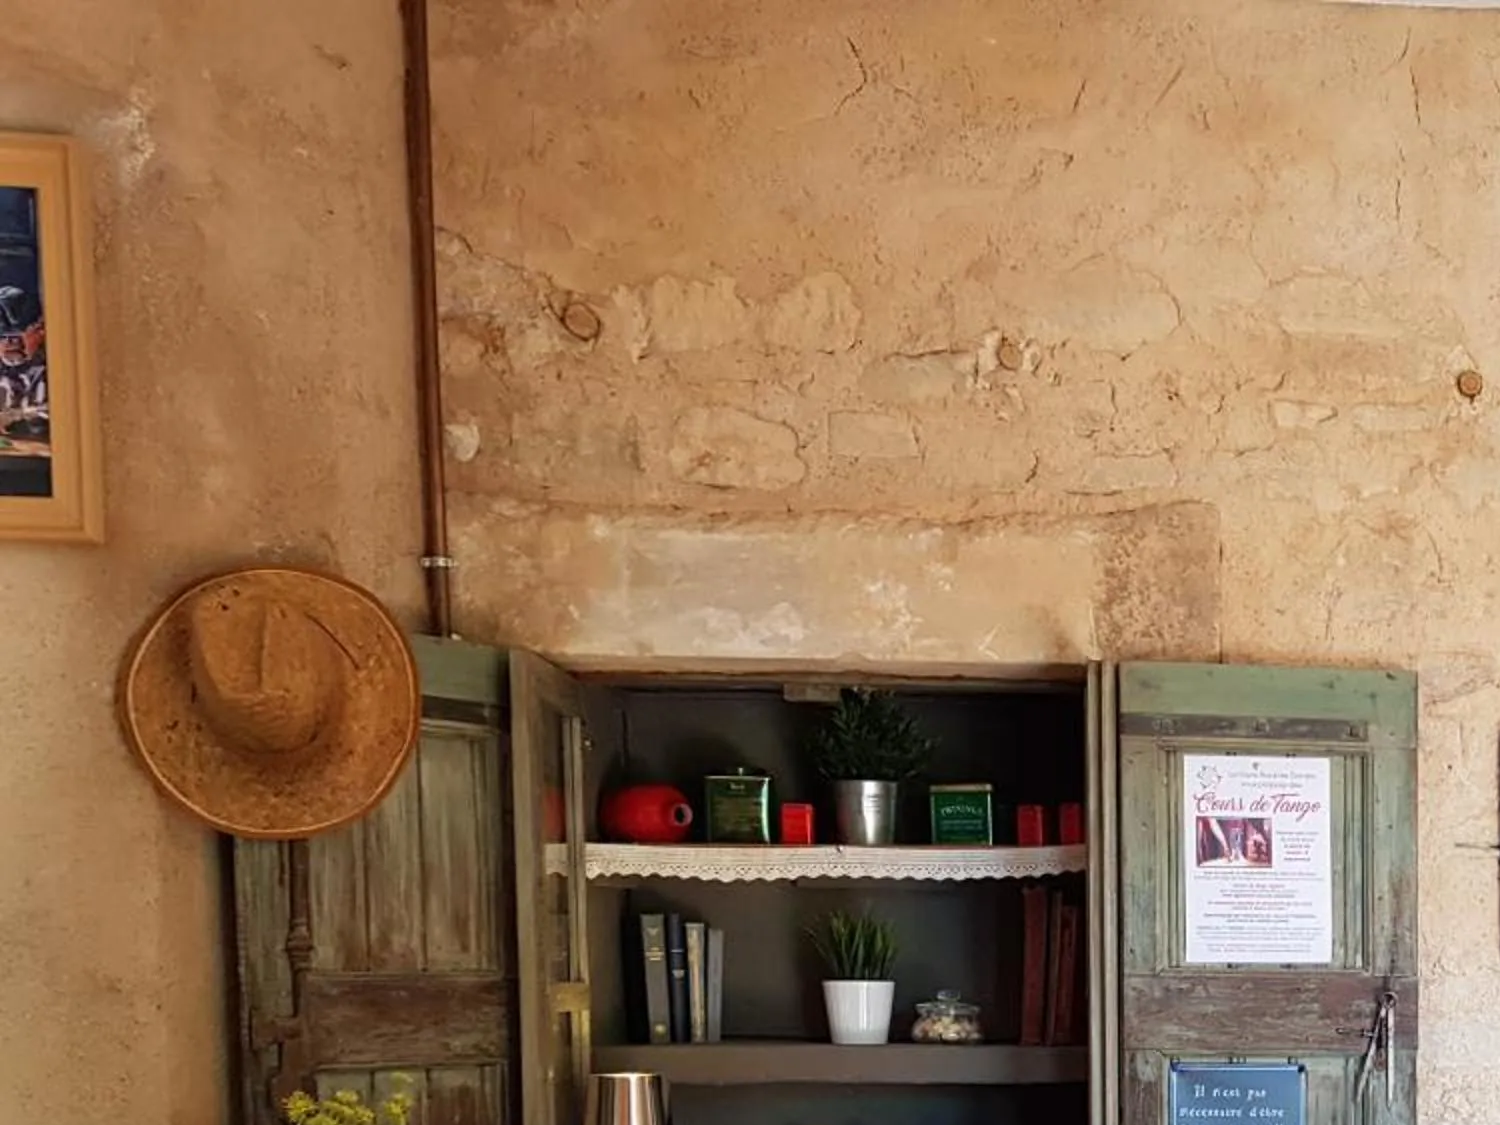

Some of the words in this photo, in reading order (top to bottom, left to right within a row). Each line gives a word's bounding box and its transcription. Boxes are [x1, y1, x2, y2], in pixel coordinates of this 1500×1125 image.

[1193, 791, 1245, 813] Cours
[1249, 794, 1270, 812] de
[1270, 793, 1322, 822] Tango
